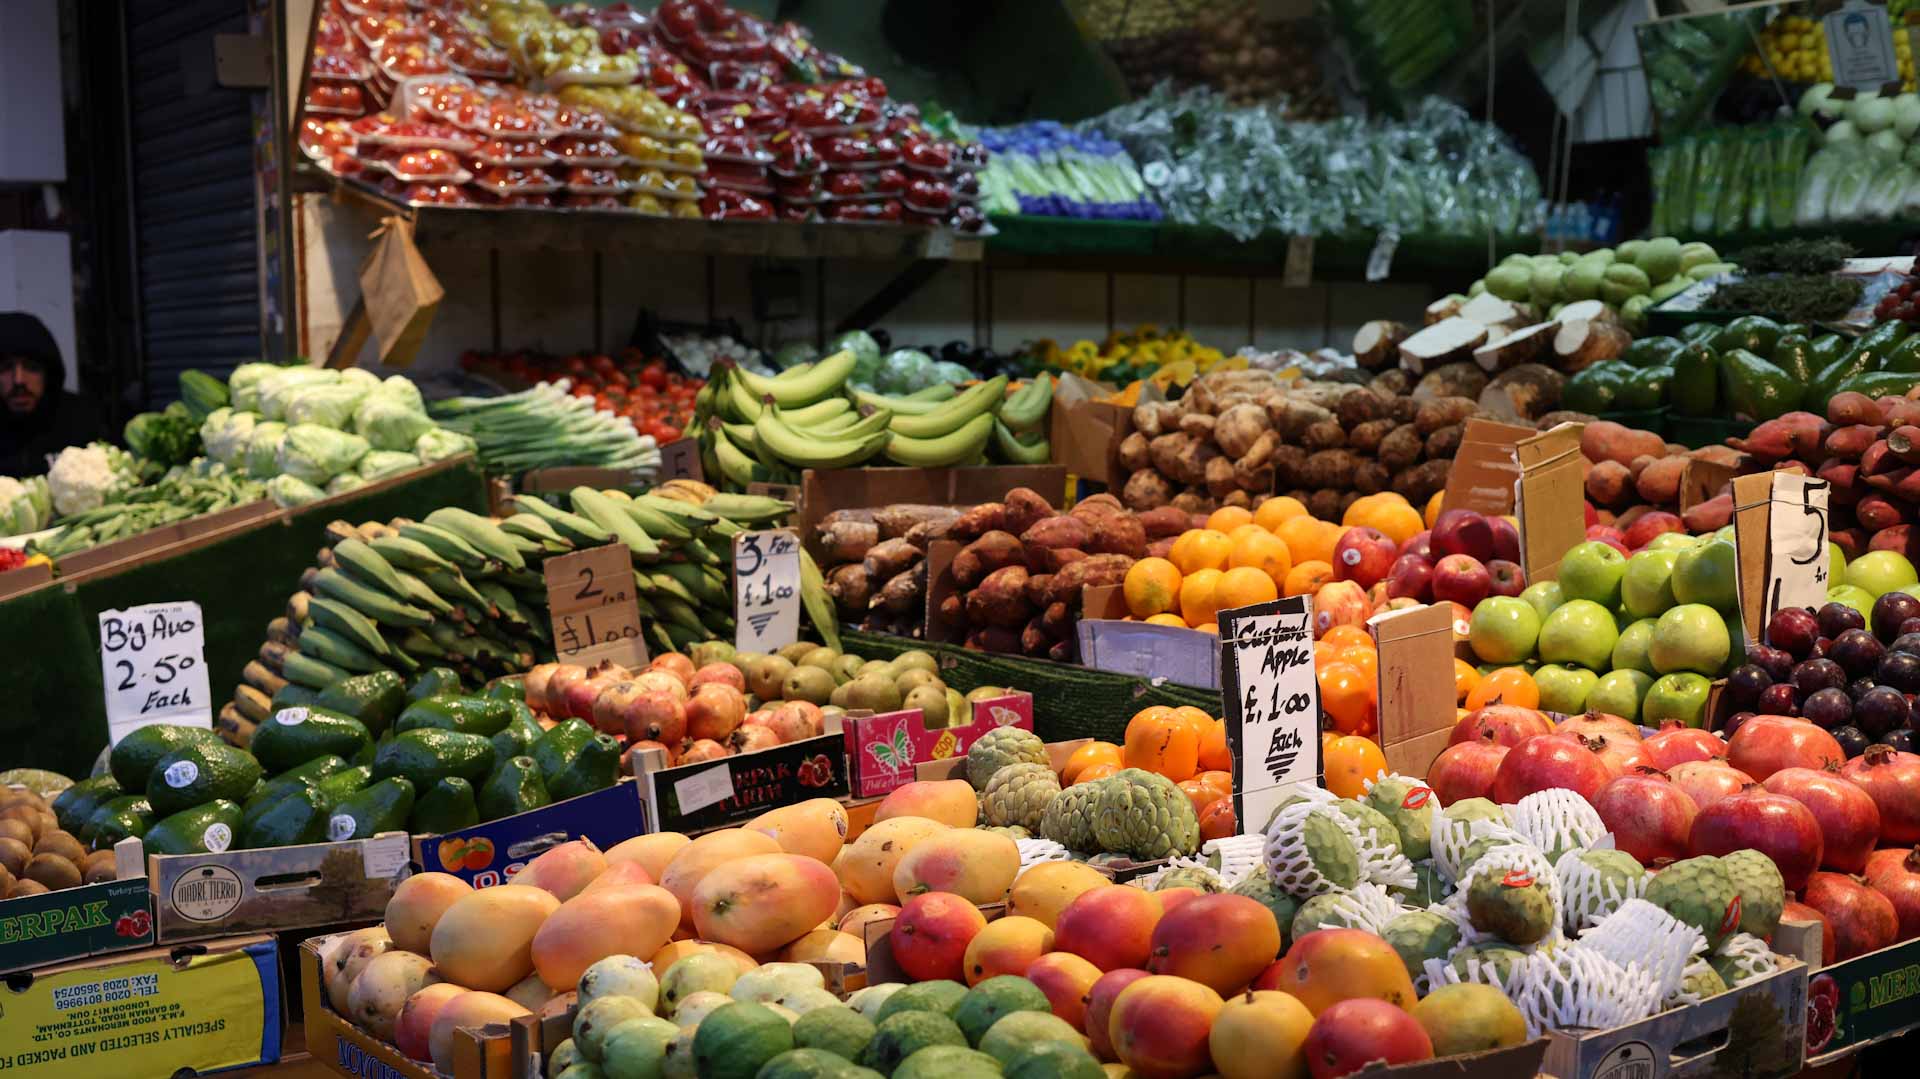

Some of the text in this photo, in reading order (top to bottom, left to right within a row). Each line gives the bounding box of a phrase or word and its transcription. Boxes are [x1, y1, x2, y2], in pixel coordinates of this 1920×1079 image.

[1791, 481, 1829, 565] 5
[576, 567, 604, 600] 2
[103, 613, 195, 652] Big Avo
[1260, 645, 1311, 680] Apple
[140, 687, 192, 714] Each
[1268, 727, 1303, 757] Each
[178, 880, 236, 903] MADRE TIERRA
[54, 973, 159, 999] FAX: 0208 3650754
[105, 989, 131, 1002] 0208
[134, 985, 160, 996] TEL:
[112, 1001, 150, 1013] LONDON
[73, 1020, 130, 1036] MERCHANTS
[131, 1016, 156, 1026] FOOD
[163, 1019, 225, 1042] SPECIALLY
[70, 1042, 97, 1057] AND
[100, 1031, 160, 1052] SELECTED
[17, 1048, 67, 1068] PACKED
